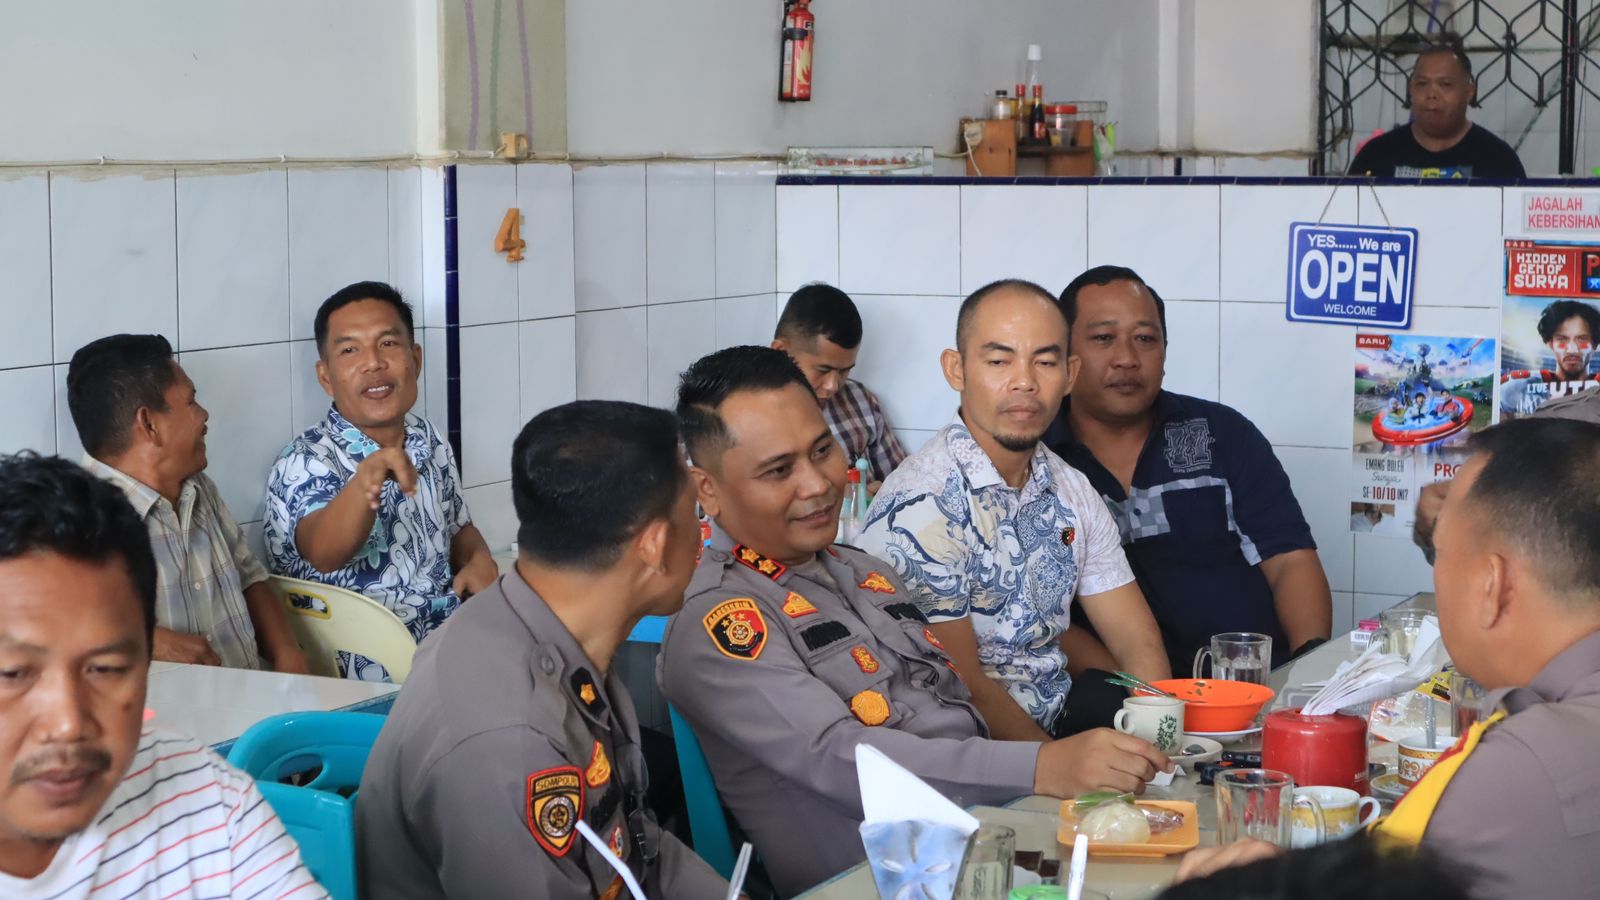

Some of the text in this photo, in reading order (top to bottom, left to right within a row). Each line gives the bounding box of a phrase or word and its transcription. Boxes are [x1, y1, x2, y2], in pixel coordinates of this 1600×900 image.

[1528, 196, 1583, 211] JAGALAH
[495, 207, 525, 262] 4
[1359, 237, 1379, 250] We
[1382, 241, 1401, 252] are
[1516, 253, 1566, 264] HIDDEN
[1300, 249, 1405, 304] OPEN
[1519, 264, 1563, 275] GEM OF
[1514, 274, 1568, 289] SURYA
[1324, 303, 1377, 316] WELCOME
[1359, 337, 1386, 345] BARU
[1365, 458, 1405, 472] EMANG BOLEH
